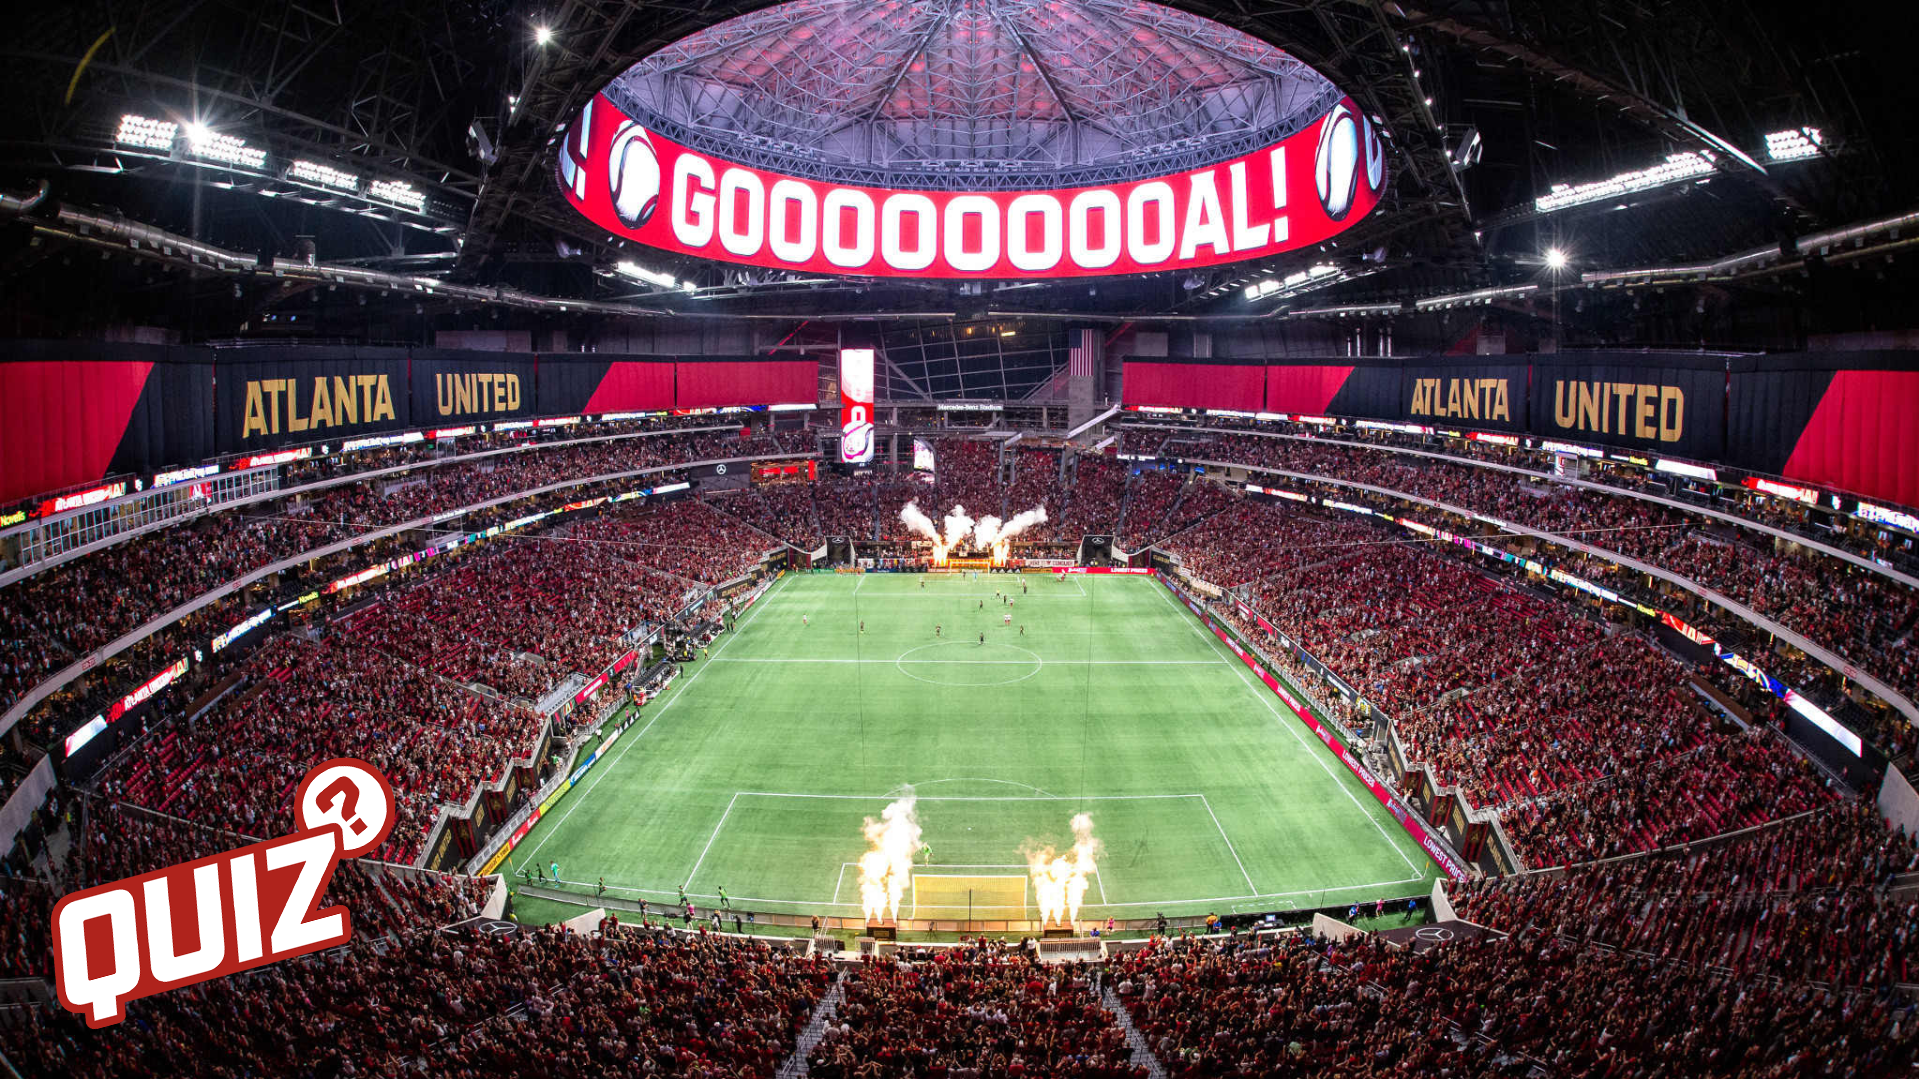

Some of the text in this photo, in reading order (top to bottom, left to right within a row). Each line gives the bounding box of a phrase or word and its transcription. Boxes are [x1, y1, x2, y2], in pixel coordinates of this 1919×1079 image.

[671, 146, 1288, 271] GOOOOOOOOAL!
[242, 373, 520, 438] ATLANTA UNITED
[1410, 378, 1685, 442] ATLANTA UNITED
[1342, 749, 1375, 788] LOWEST PRICES
[1423, 835, 1448, 868] LOWEST
